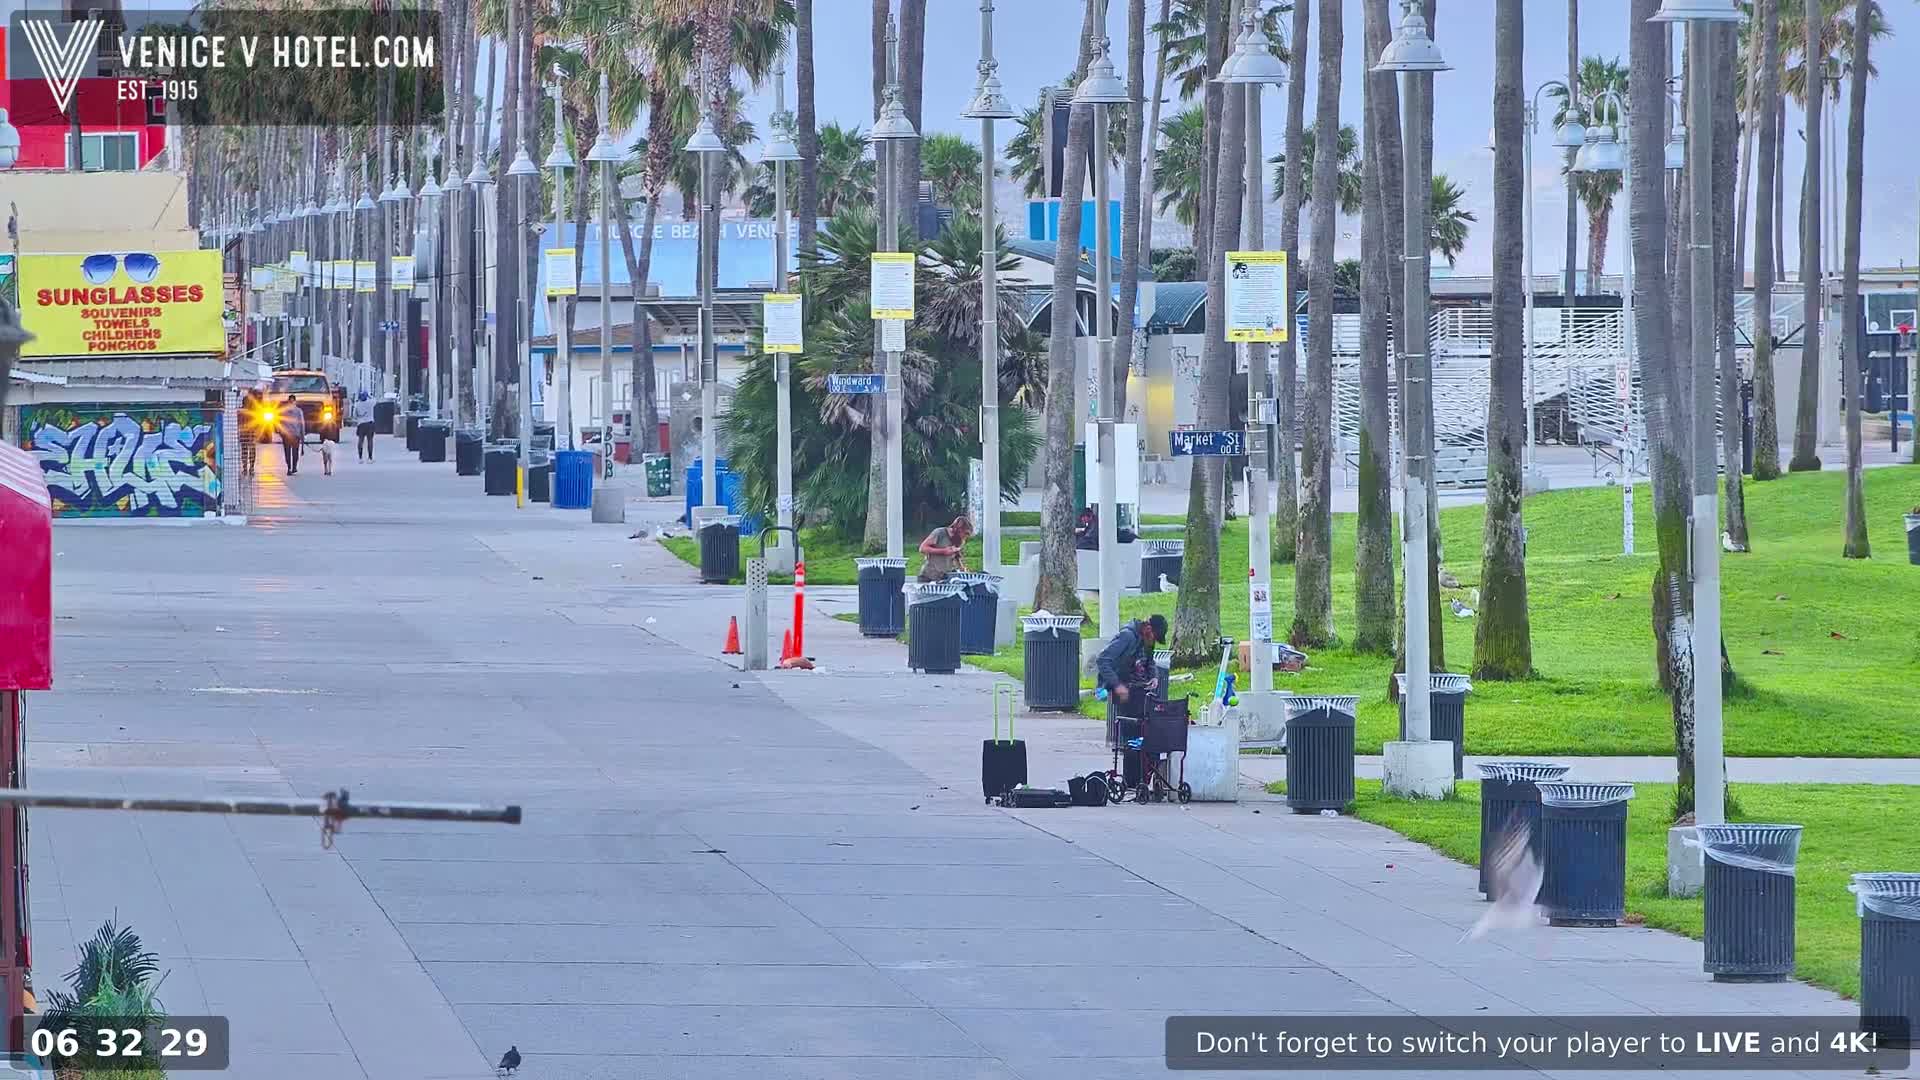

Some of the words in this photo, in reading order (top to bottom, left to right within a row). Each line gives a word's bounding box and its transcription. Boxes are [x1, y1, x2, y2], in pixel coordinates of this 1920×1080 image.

[595, 224, 664, 239] MUCE
[671, 224, 727, 239] BEAH
[736, 224, 797, 239] VENIE
[37, 285, 204, 306] SUNGLASSES
[81, 307, 162, 319] SOUVENIRS
[94, 318, 150, 330] TOWELS
[82, 329, 162, 341] CHILDRENS
[88, 340, 157, 352] PONCHOS
[831, 375, 872, 386] Windward
[1174, 432, 1214, 447] Market
[1227, 432, 1240, 445] St
[1234, 445, 1240, 454] E
